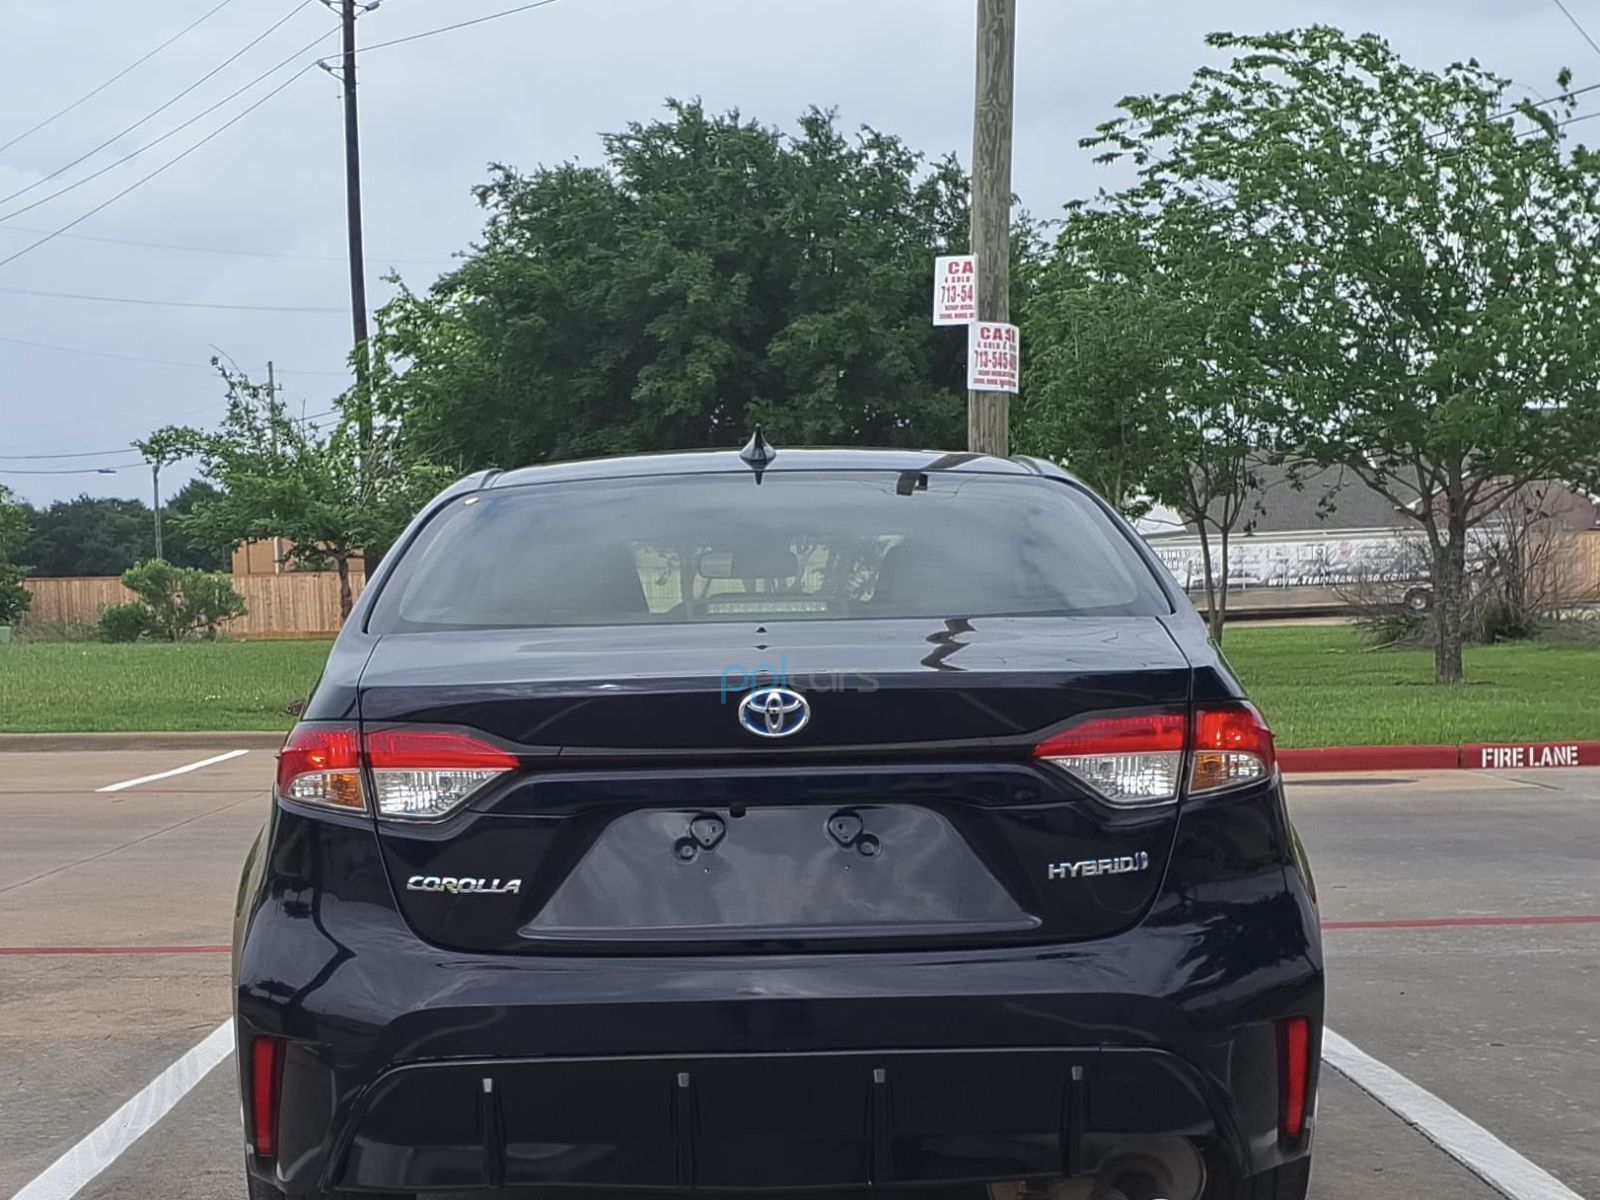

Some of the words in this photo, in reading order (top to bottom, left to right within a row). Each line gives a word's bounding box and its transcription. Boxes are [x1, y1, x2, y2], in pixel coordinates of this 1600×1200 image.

[941, 285, 973, 304] 713-54
[1482, 747, 1525, 768] FIRE
[1529, 745, 1579, 767] LANE
[1048, 856, 1136, 880] HYBRID
[406, 875, 522, 895] COROLLA
